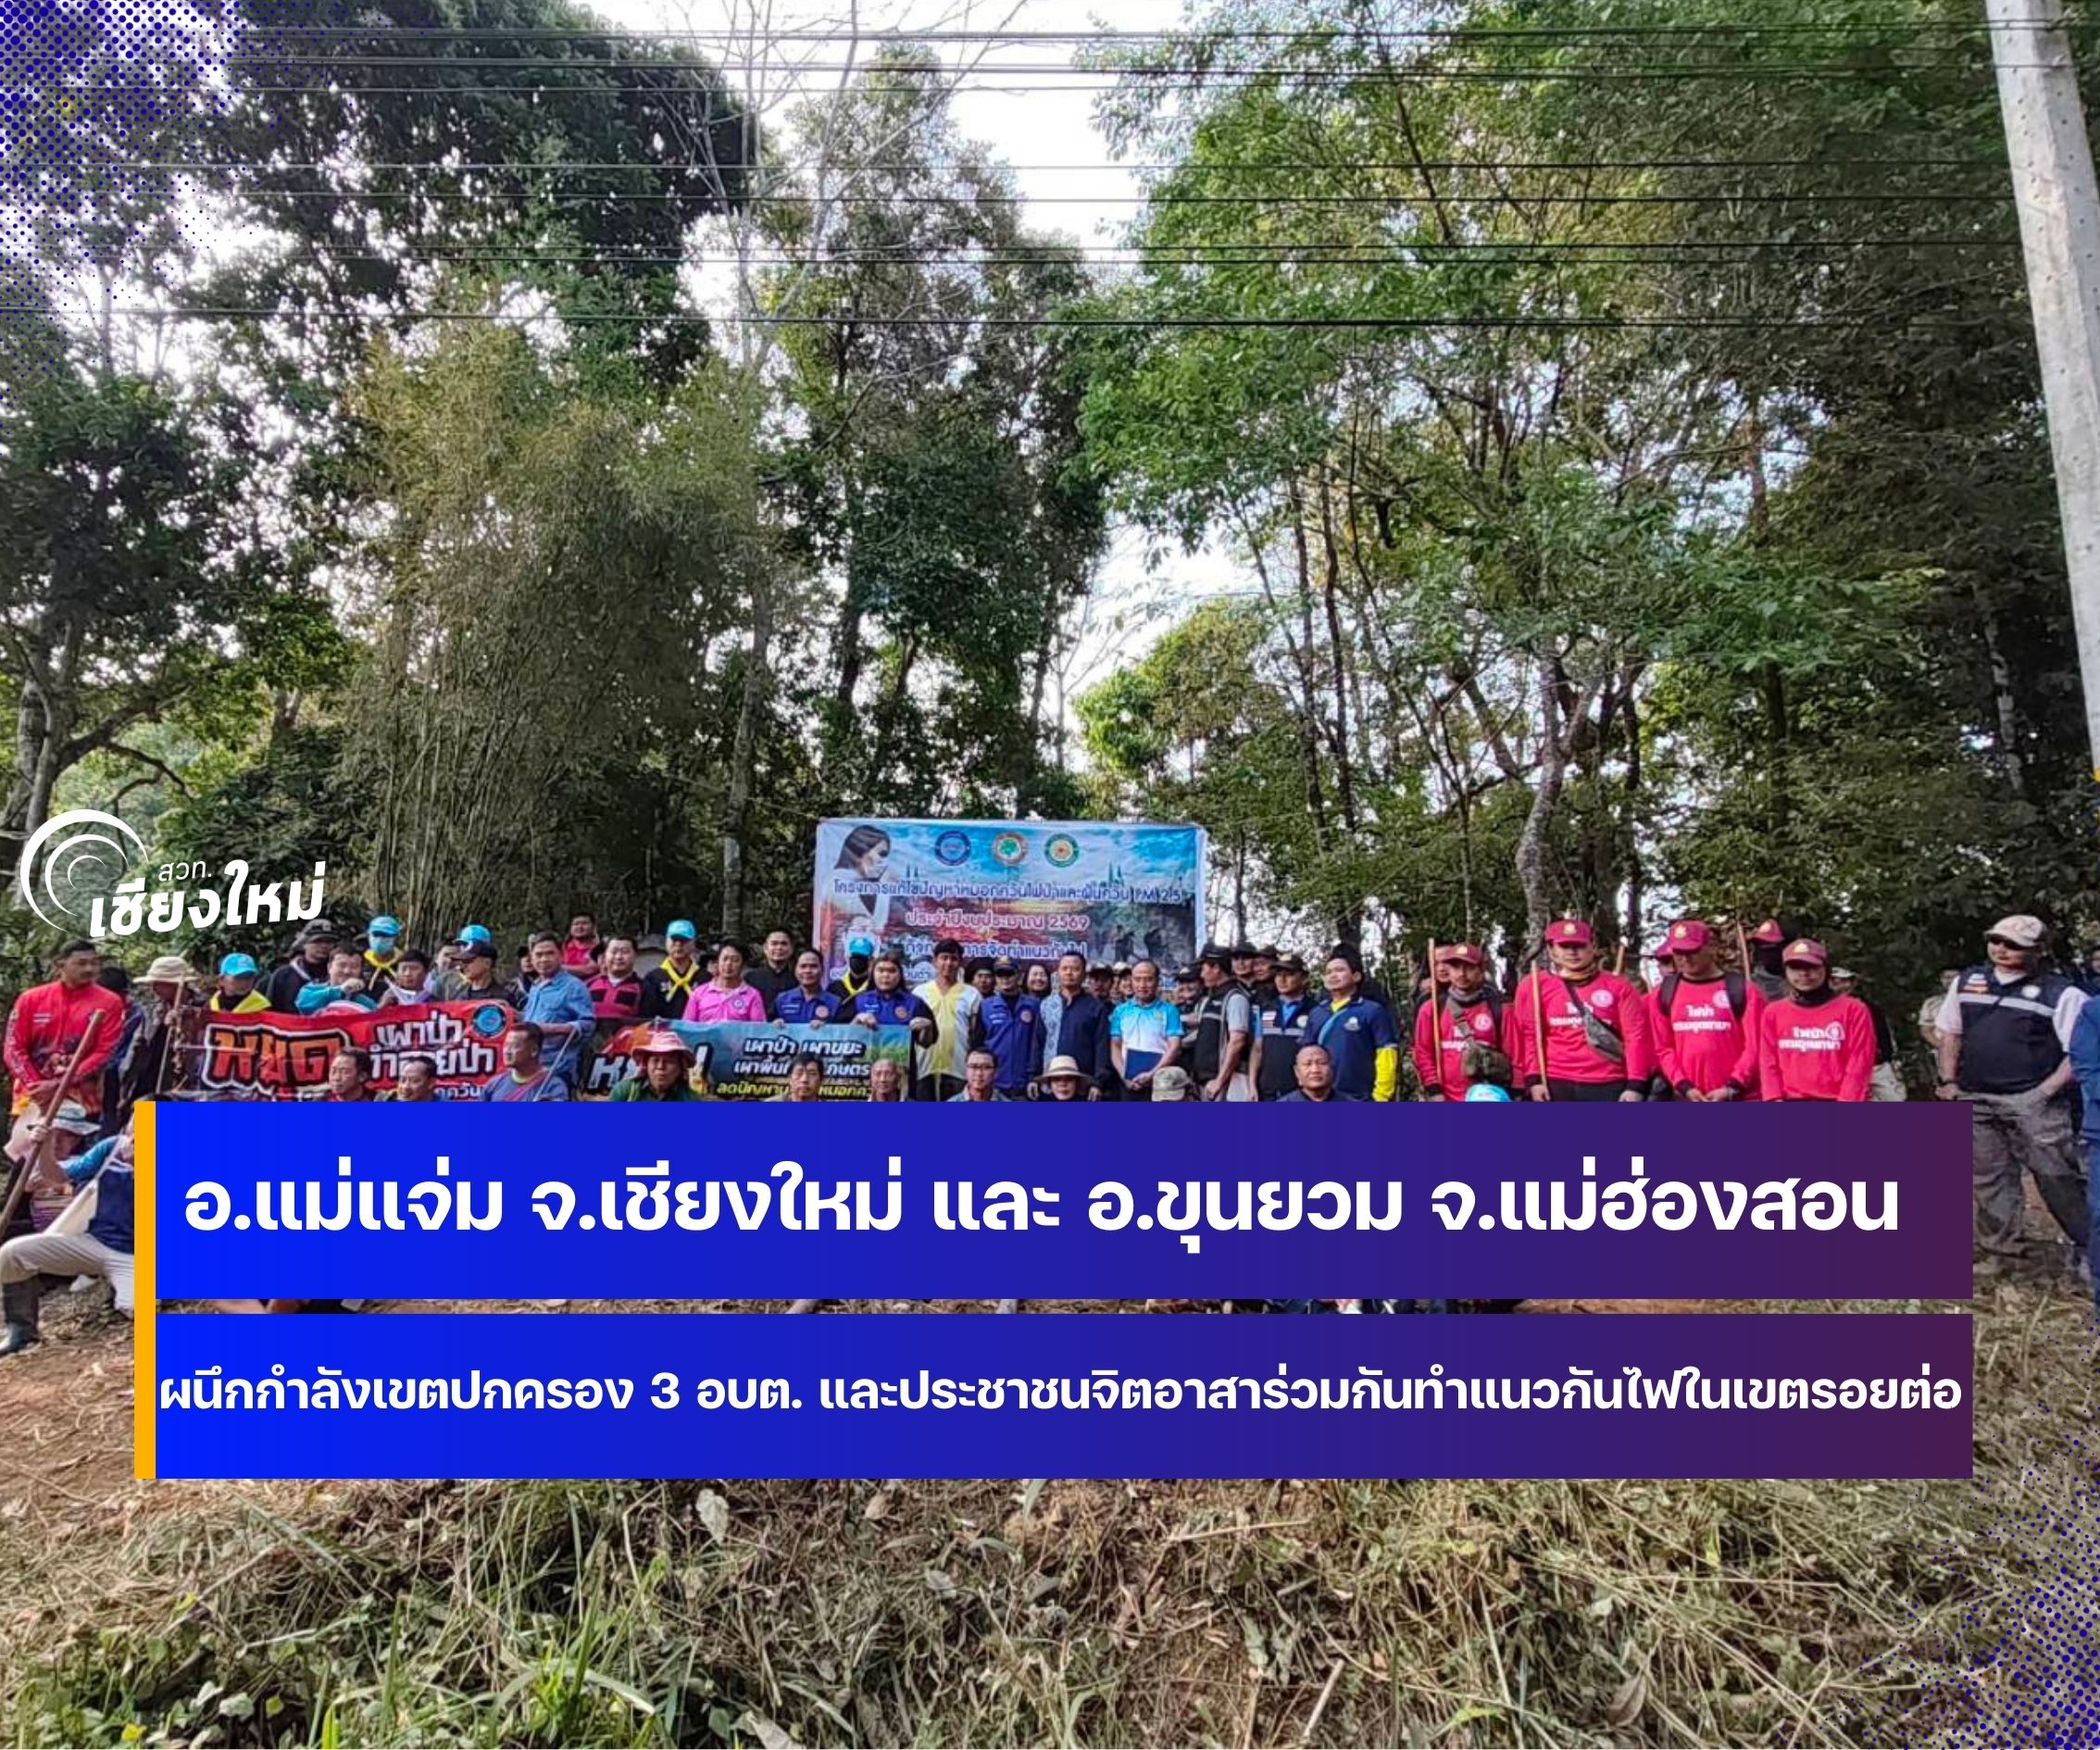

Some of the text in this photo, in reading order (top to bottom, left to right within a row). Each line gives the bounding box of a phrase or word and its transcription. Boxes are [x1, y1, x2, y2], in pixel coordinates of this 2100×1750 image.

[905, 907, 1091, 931] ประจำปีงบประมาณ 2569
[376, 1009, 464, 1049] เผาป่า
[369, 1038, 495, 1081] ทำยป่า
[744, 1035, 865, 1056] เผาป่า เผาขยะ
